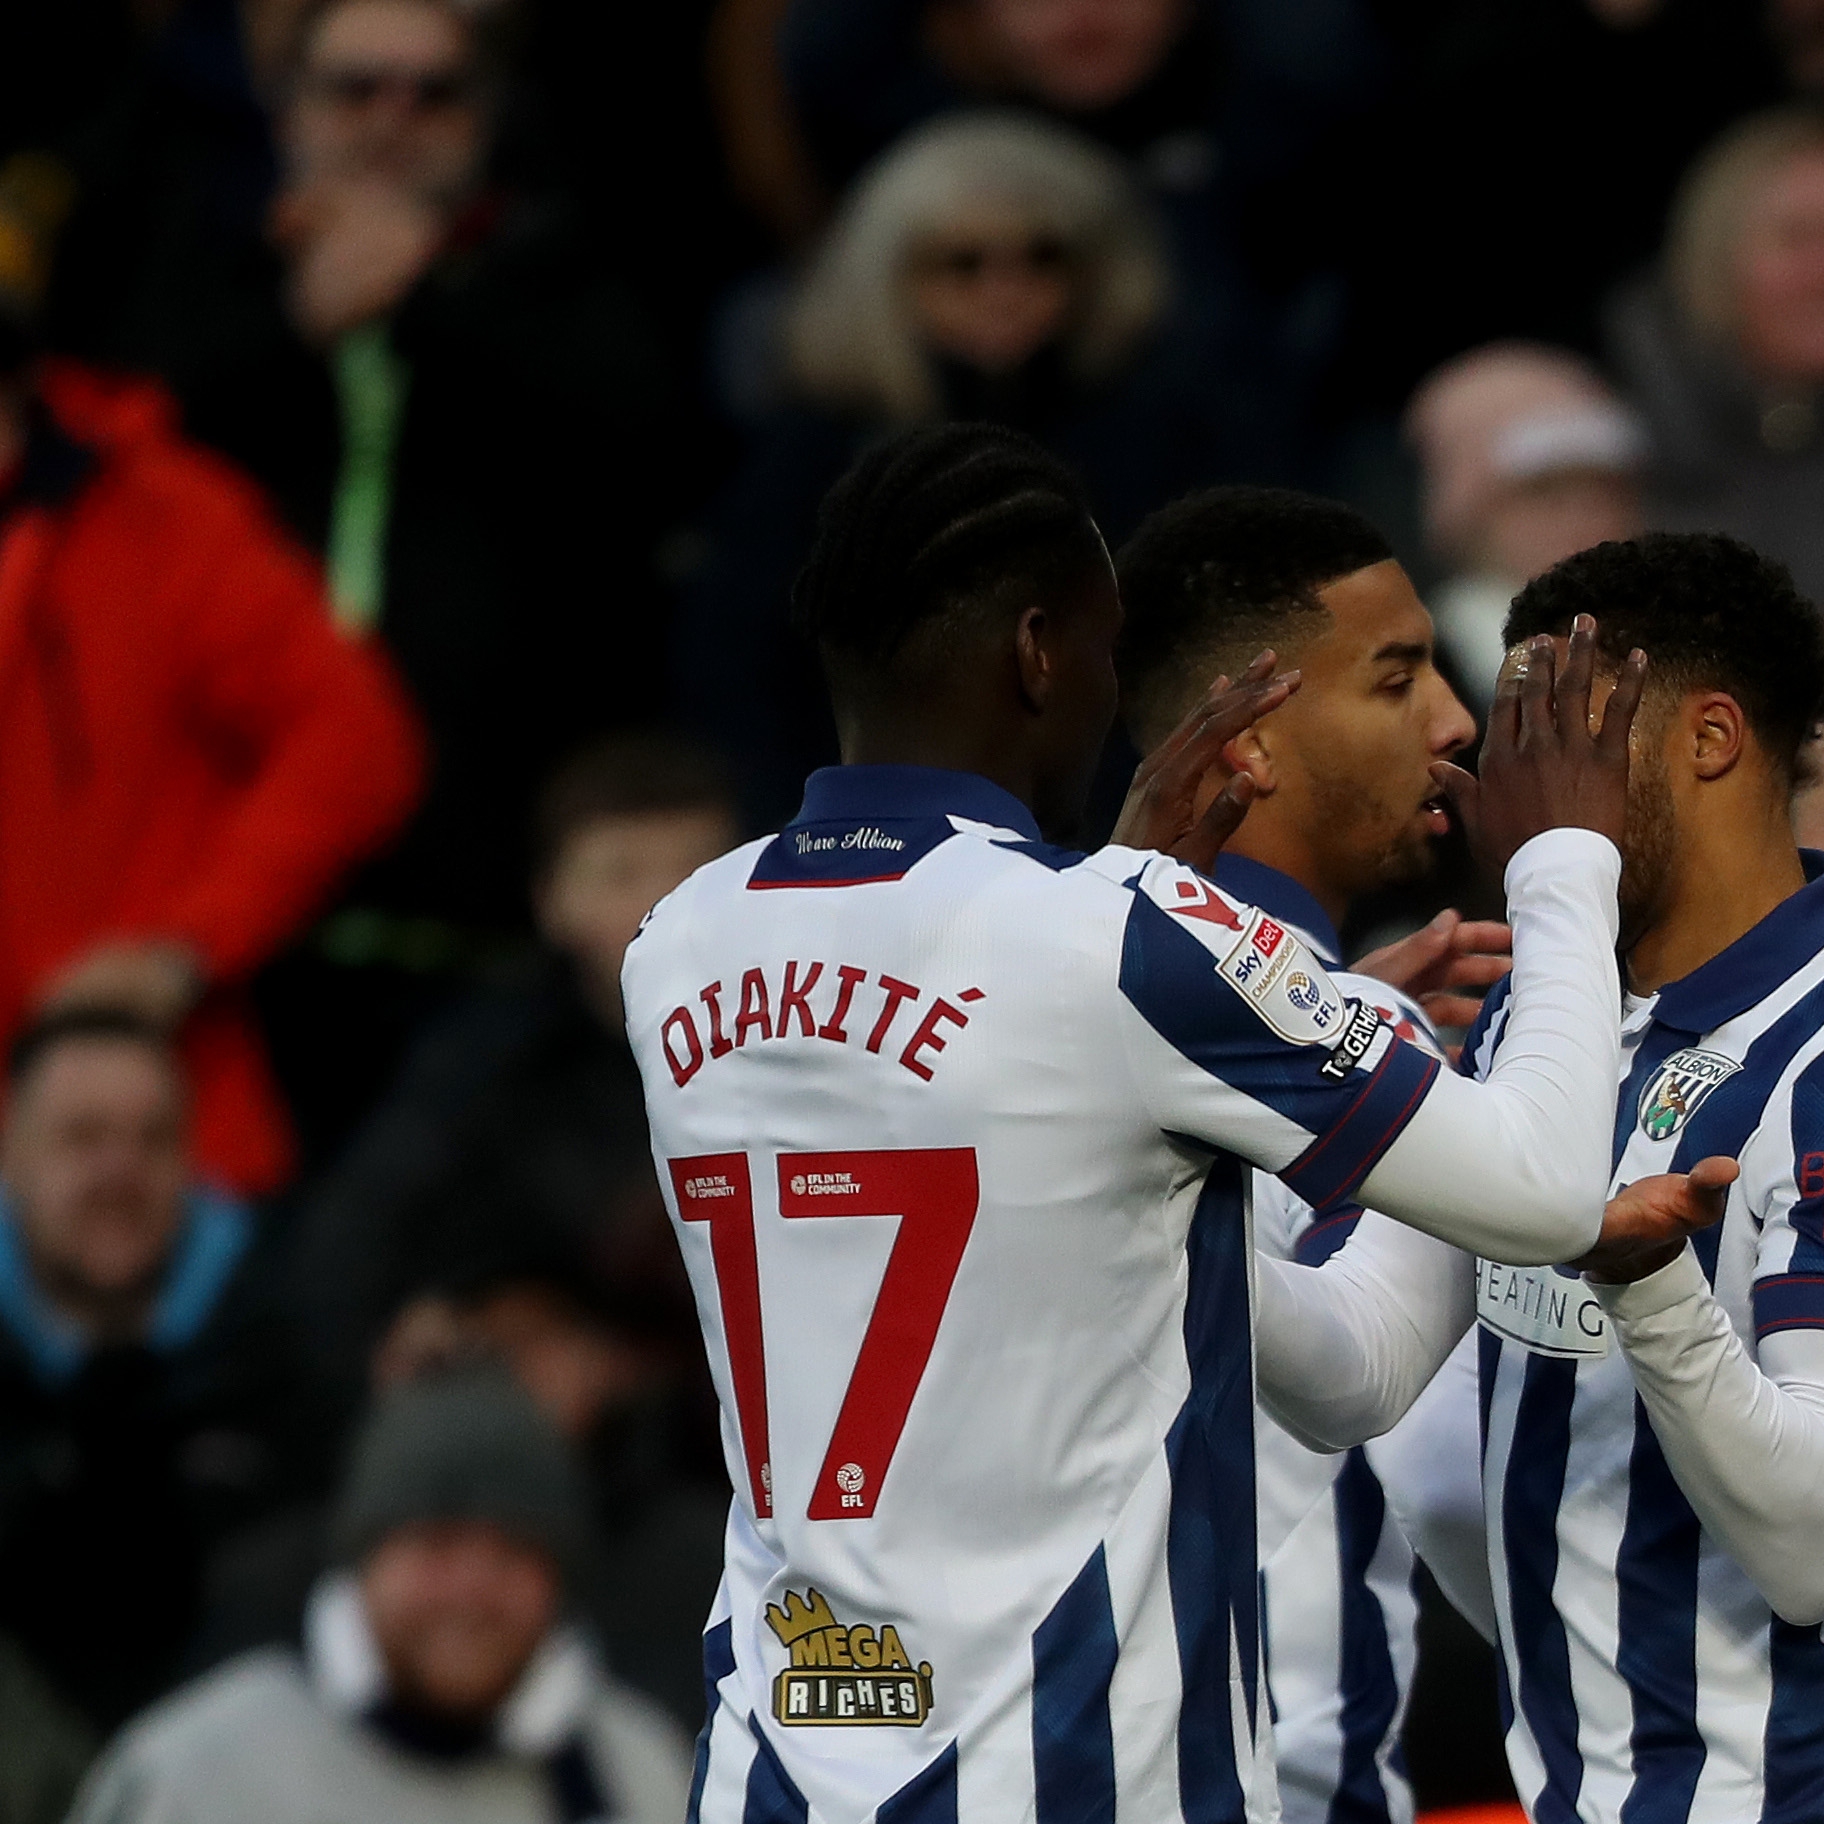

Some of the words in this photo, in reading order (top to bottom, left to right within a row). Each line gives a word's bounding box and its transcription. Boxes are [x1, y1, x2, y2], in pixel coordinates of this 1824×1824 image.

[840, 827, 906, 851] Albion
[1235, 948, 1263, 983] sky
[1255, 921, 1280, 957] bet
[1253, 938, 1295, 998] CHAMPIONSHIP
[661, 961, 986, 1088] DIAKITÉ
[1313, 1001, 1337, 1028] EFL
[1667, 1056, 1728, 1082] ALBION
[808, 1183, 861, 1196] COMMUNITY
[667, 1146, 981, 1520] 17
[841, 1494, 865, 1508] EFL
[790, 1624, 912, 1669] MEGA
[788, 1679, 917, 1717] RICHES
